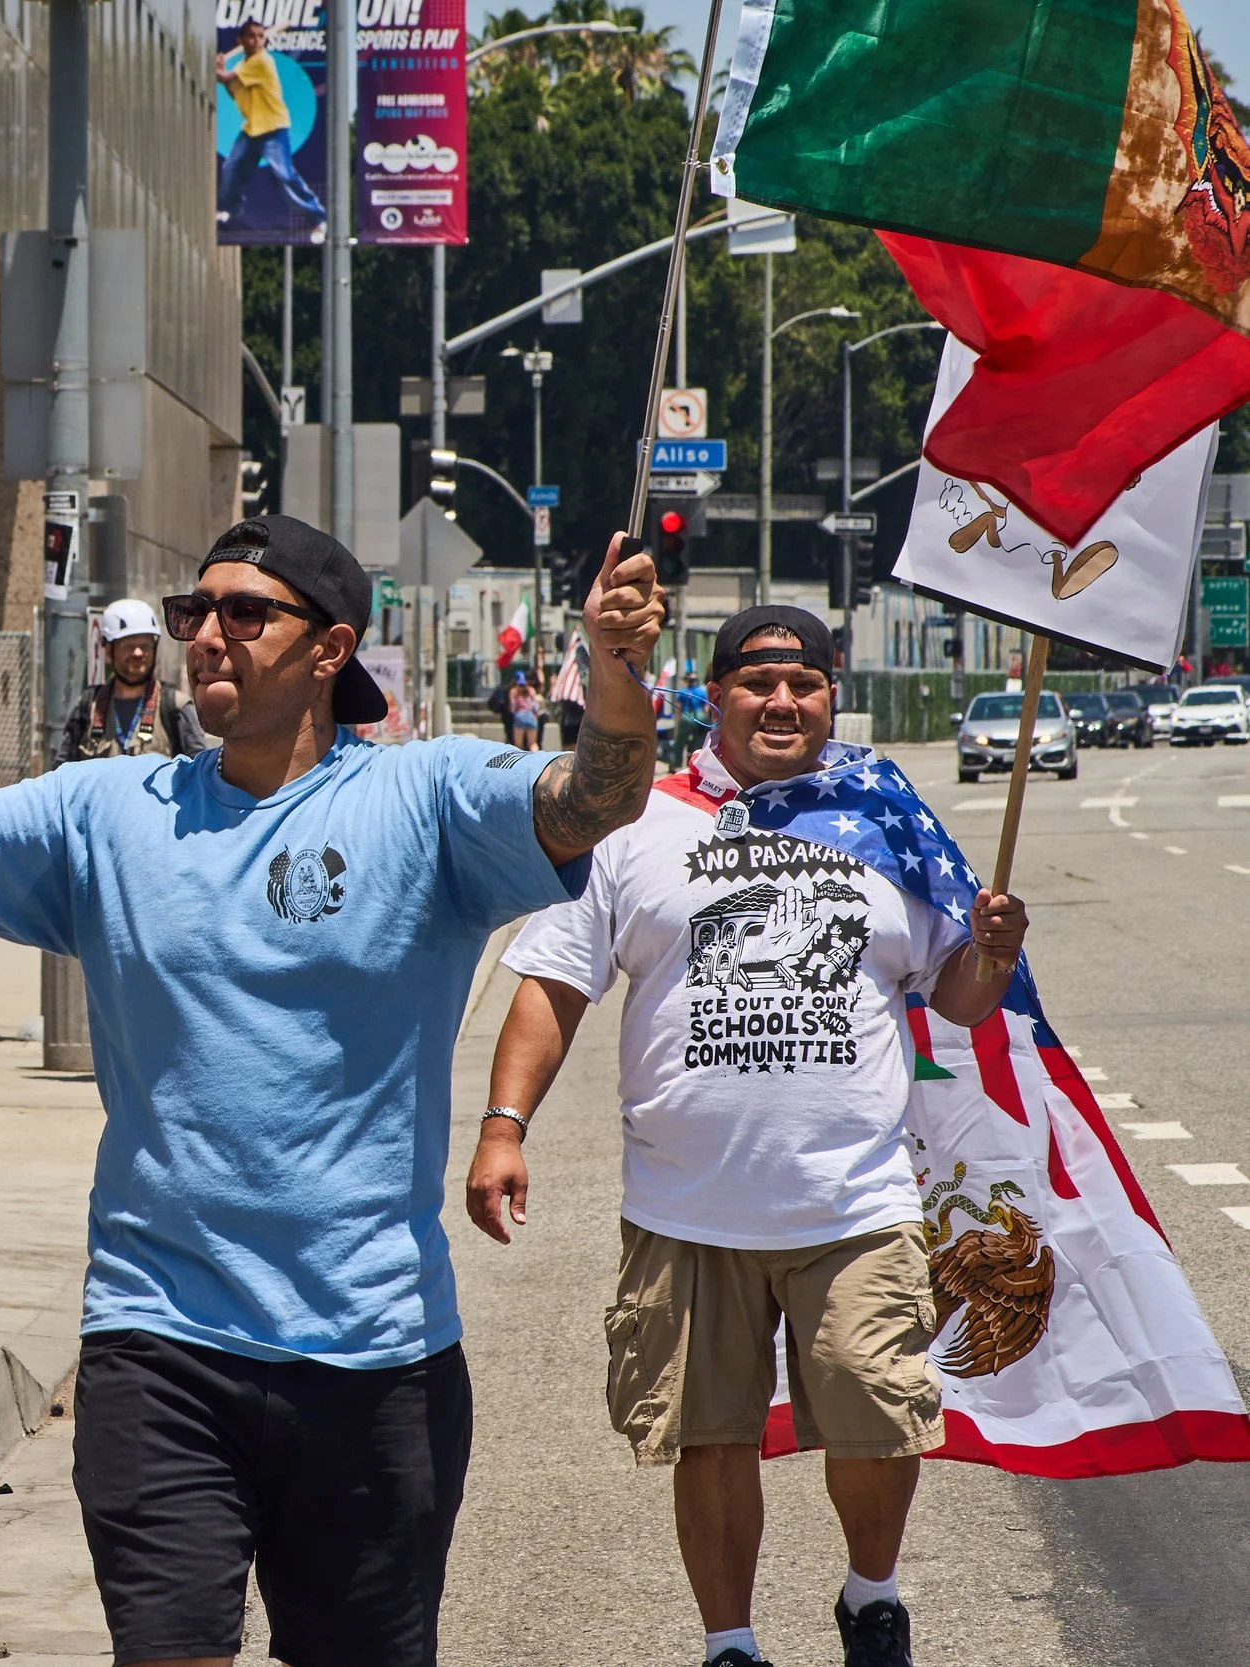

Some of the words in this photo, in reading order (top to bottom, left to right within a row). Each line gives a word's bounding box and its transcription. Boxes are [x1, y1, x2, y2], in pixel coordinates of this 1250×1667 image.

[267, 31, 327, 51] SCIENCE,
[356, 30, 408, 50] SPORTS
[409, 30, 422, 49] &
[422, 29, 459, 49] PLAY
[654, 446, 709, 463] Aliso
[703, 780, 723, 793] ANLEY
[690, 998, 728, 1018] ICE
[735, 997, 774, 1011] OUT
[781, 996, 804, 1010] OF
[813, 996, 848, 1010] OUR
[690, 1011, 819, 1042] SCHOOLS
[820, 1010, 846, 1033] AND
[685, 1039, 858, 1066] COMMUNITIES
